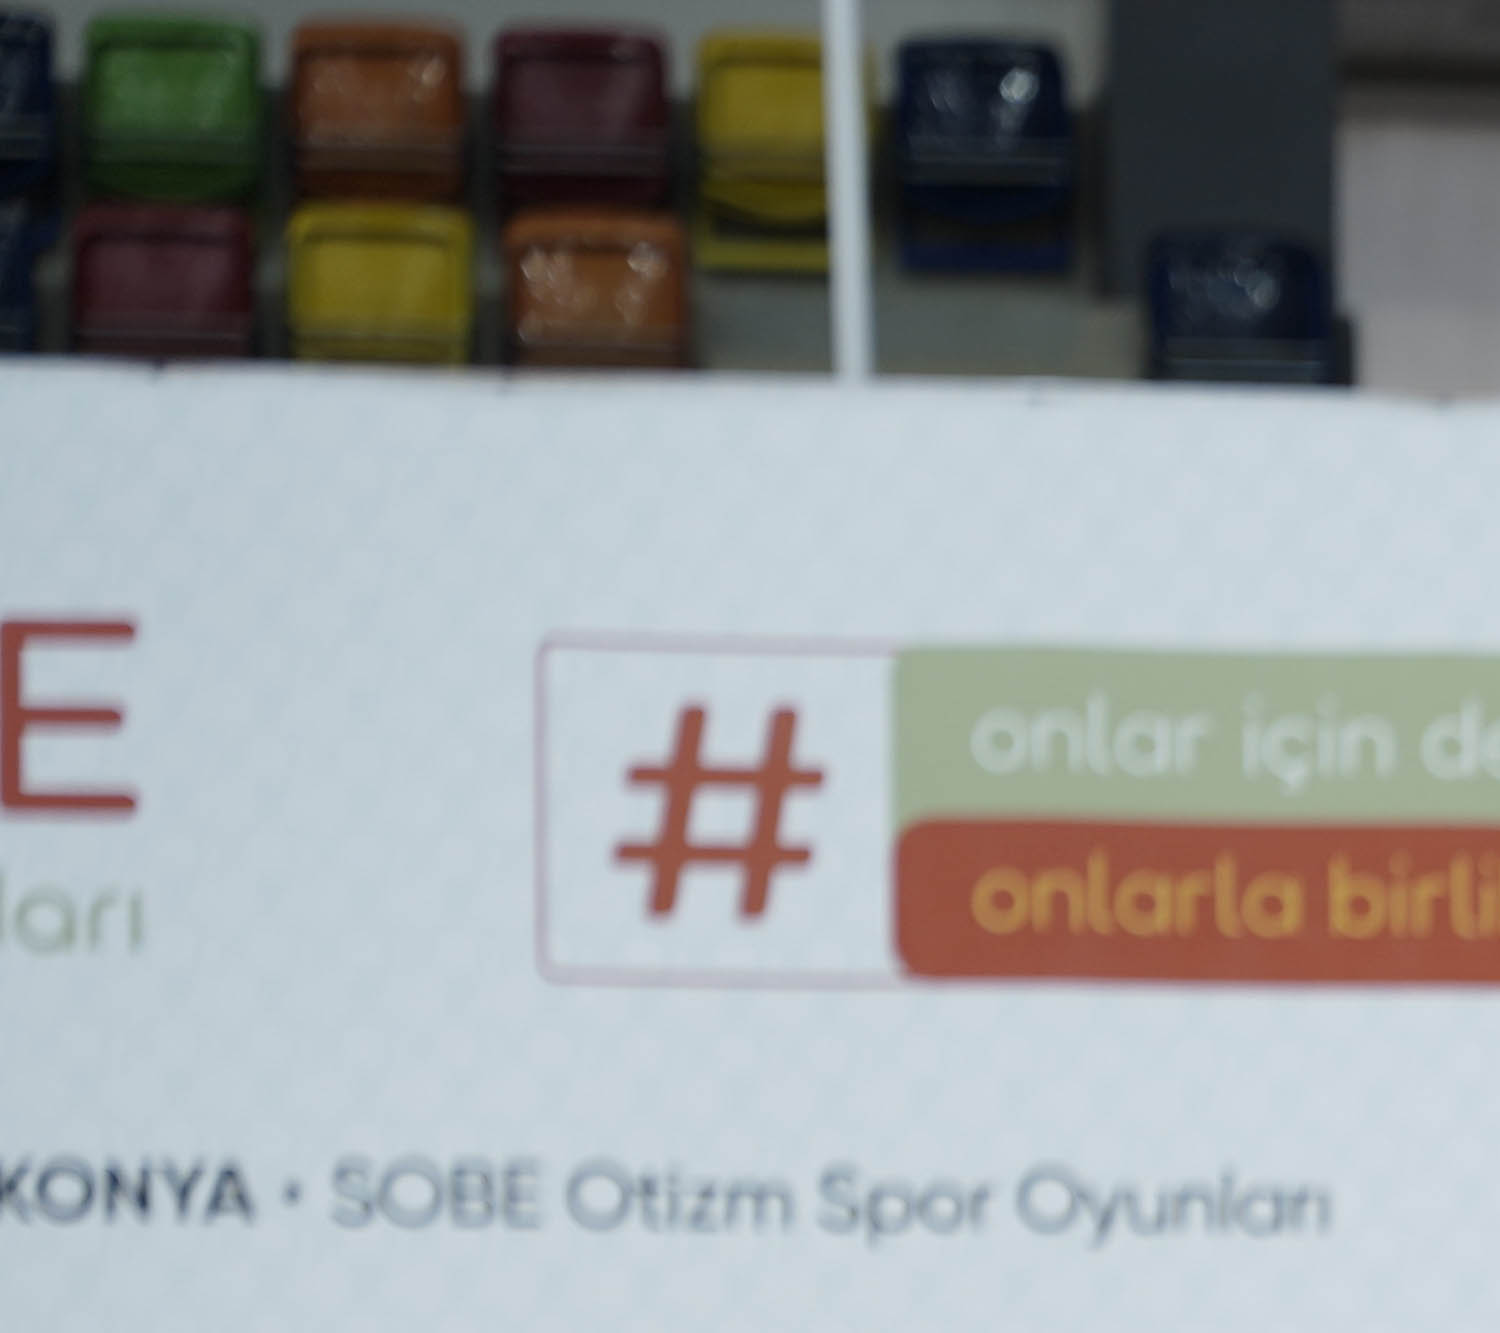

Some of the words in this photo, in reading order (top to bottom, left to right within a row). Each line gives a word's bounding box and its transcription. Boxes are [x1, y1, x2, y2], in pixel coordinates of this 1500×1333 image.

[969, 689, 1209, 778] onlar
[1242, 691, 1397, 794] için
[970, 847, 1305, 939] onlarla
[0, 1154, 255, 1228] KONYA
[331, 1153, 541, 1231] SOBE
[565, 1153, 796, 1236] Otizm
[815, 1158, 992, 1248] Spor
